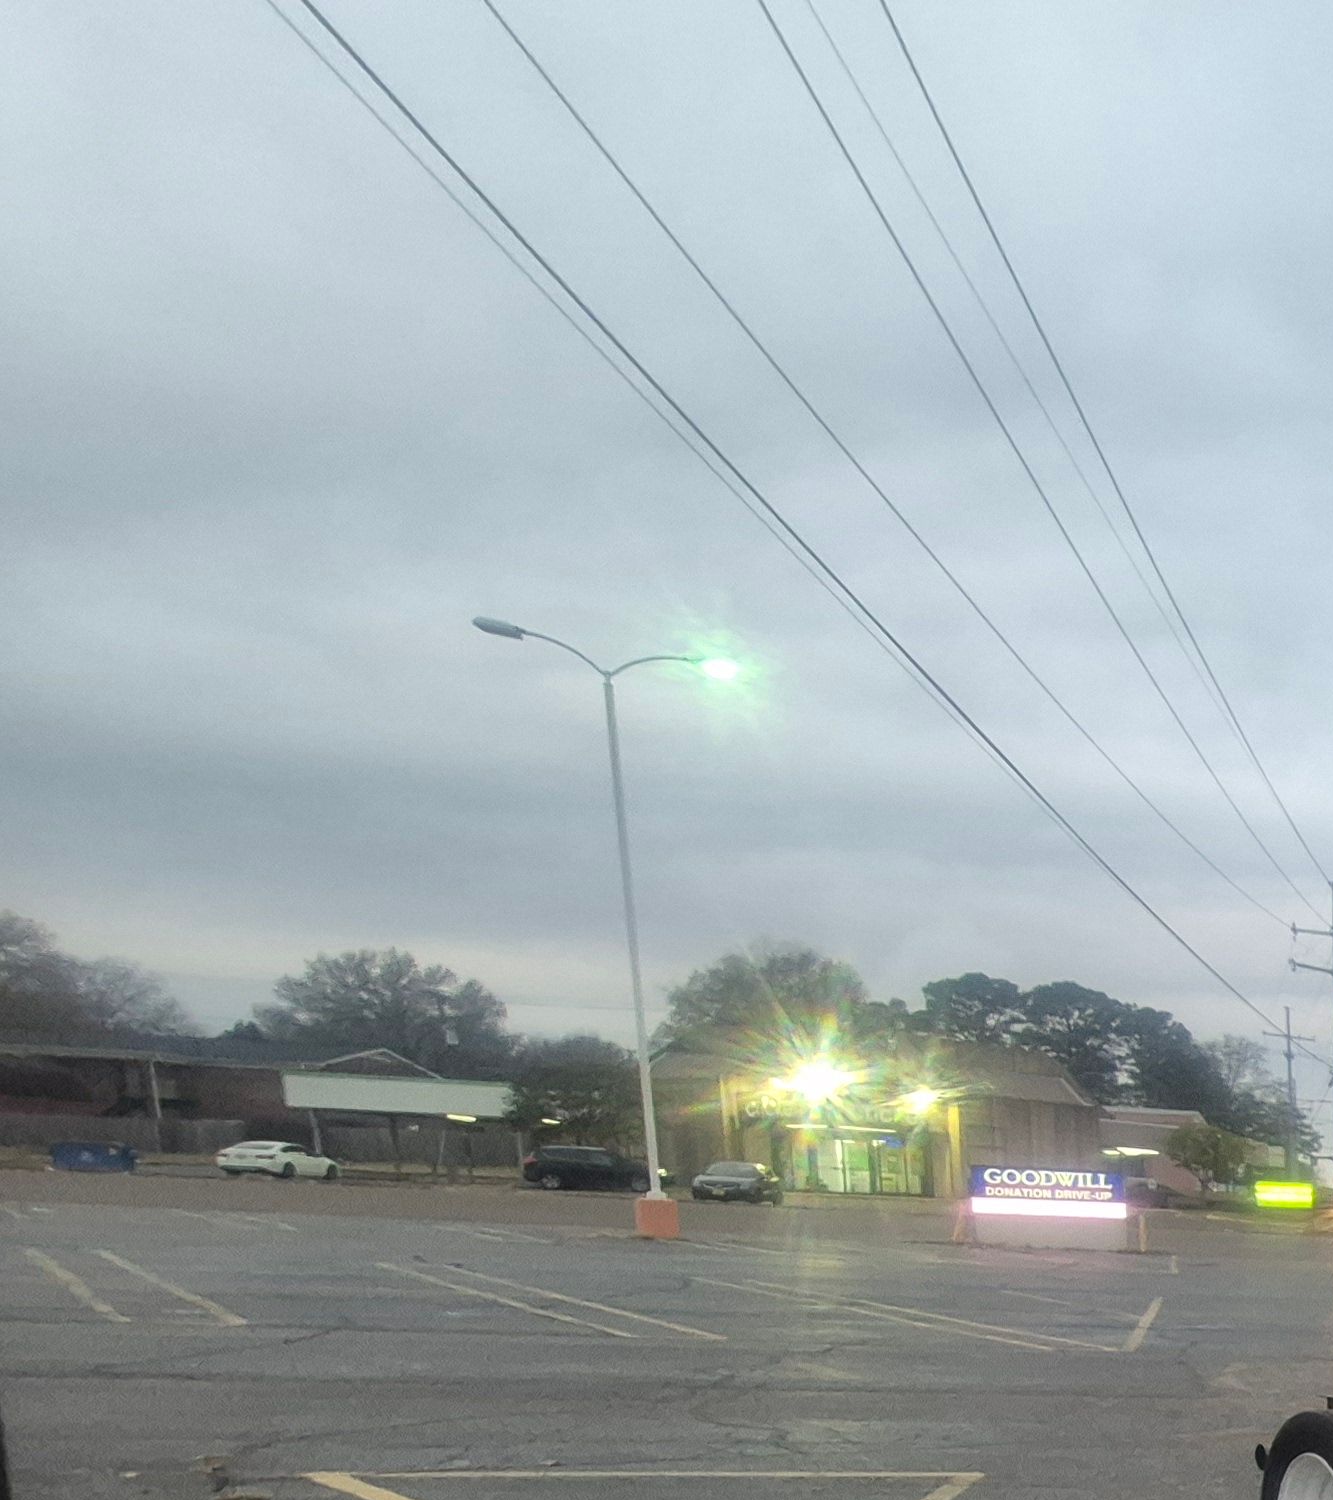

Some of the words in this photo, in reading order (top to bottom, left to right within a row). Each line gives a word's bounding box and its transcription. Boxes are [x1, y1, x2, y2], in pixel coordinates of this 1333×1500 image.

[983, 1168, 1113, 1189] GOODWILL
[986, 1187, 1052, 1198] DONATION
[1055, 1190, 1113, 1200] DRIVE-UP
